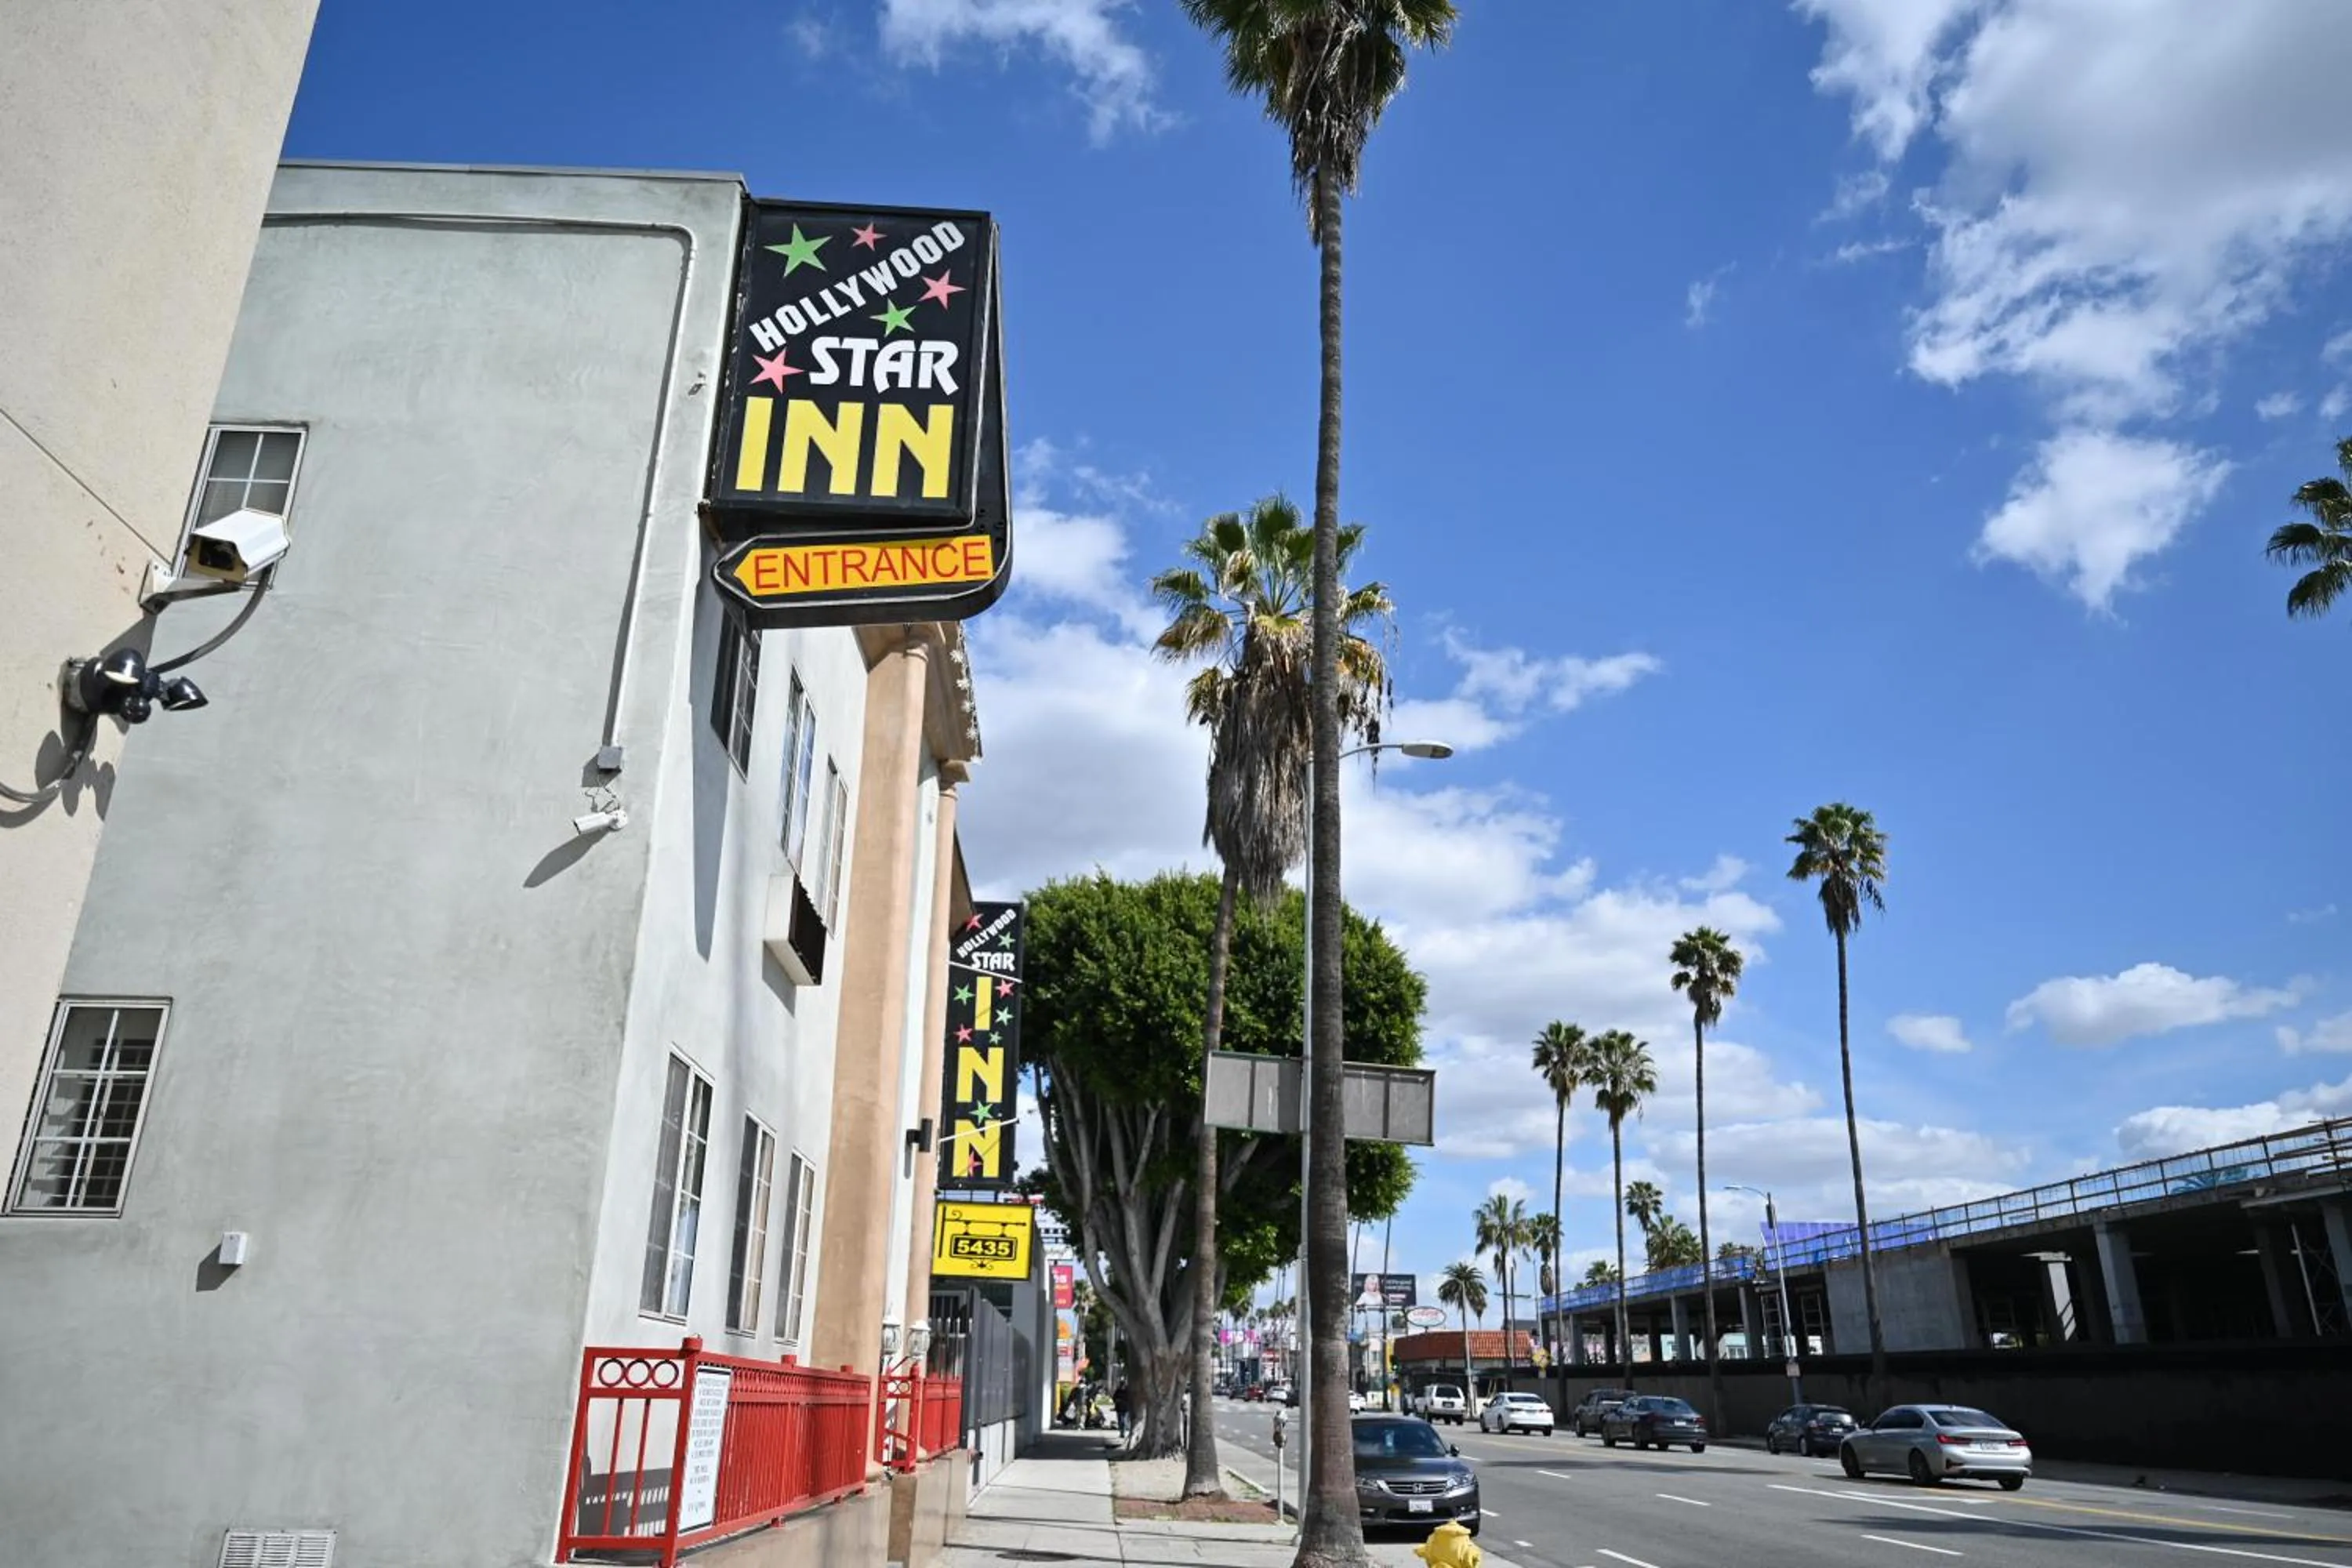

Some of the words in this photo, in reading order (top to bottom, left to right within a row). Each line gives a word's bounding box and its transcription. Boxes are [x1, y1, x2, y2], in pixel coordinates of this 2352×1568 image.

[750, 220, 966, 352] HOLLYWOOD
[810, 336, 959, 396] STAR
[735, 396, 955, 498] INN
[753, 542, 988, 589] ENTRANCE
[956, 909, 1016, 958] HOLLYWOOD
[971, 951, 1015, 971] STAR
[952, 977, 1004, 1178] INN
[956, 1240, 1011, 1256] 5435
